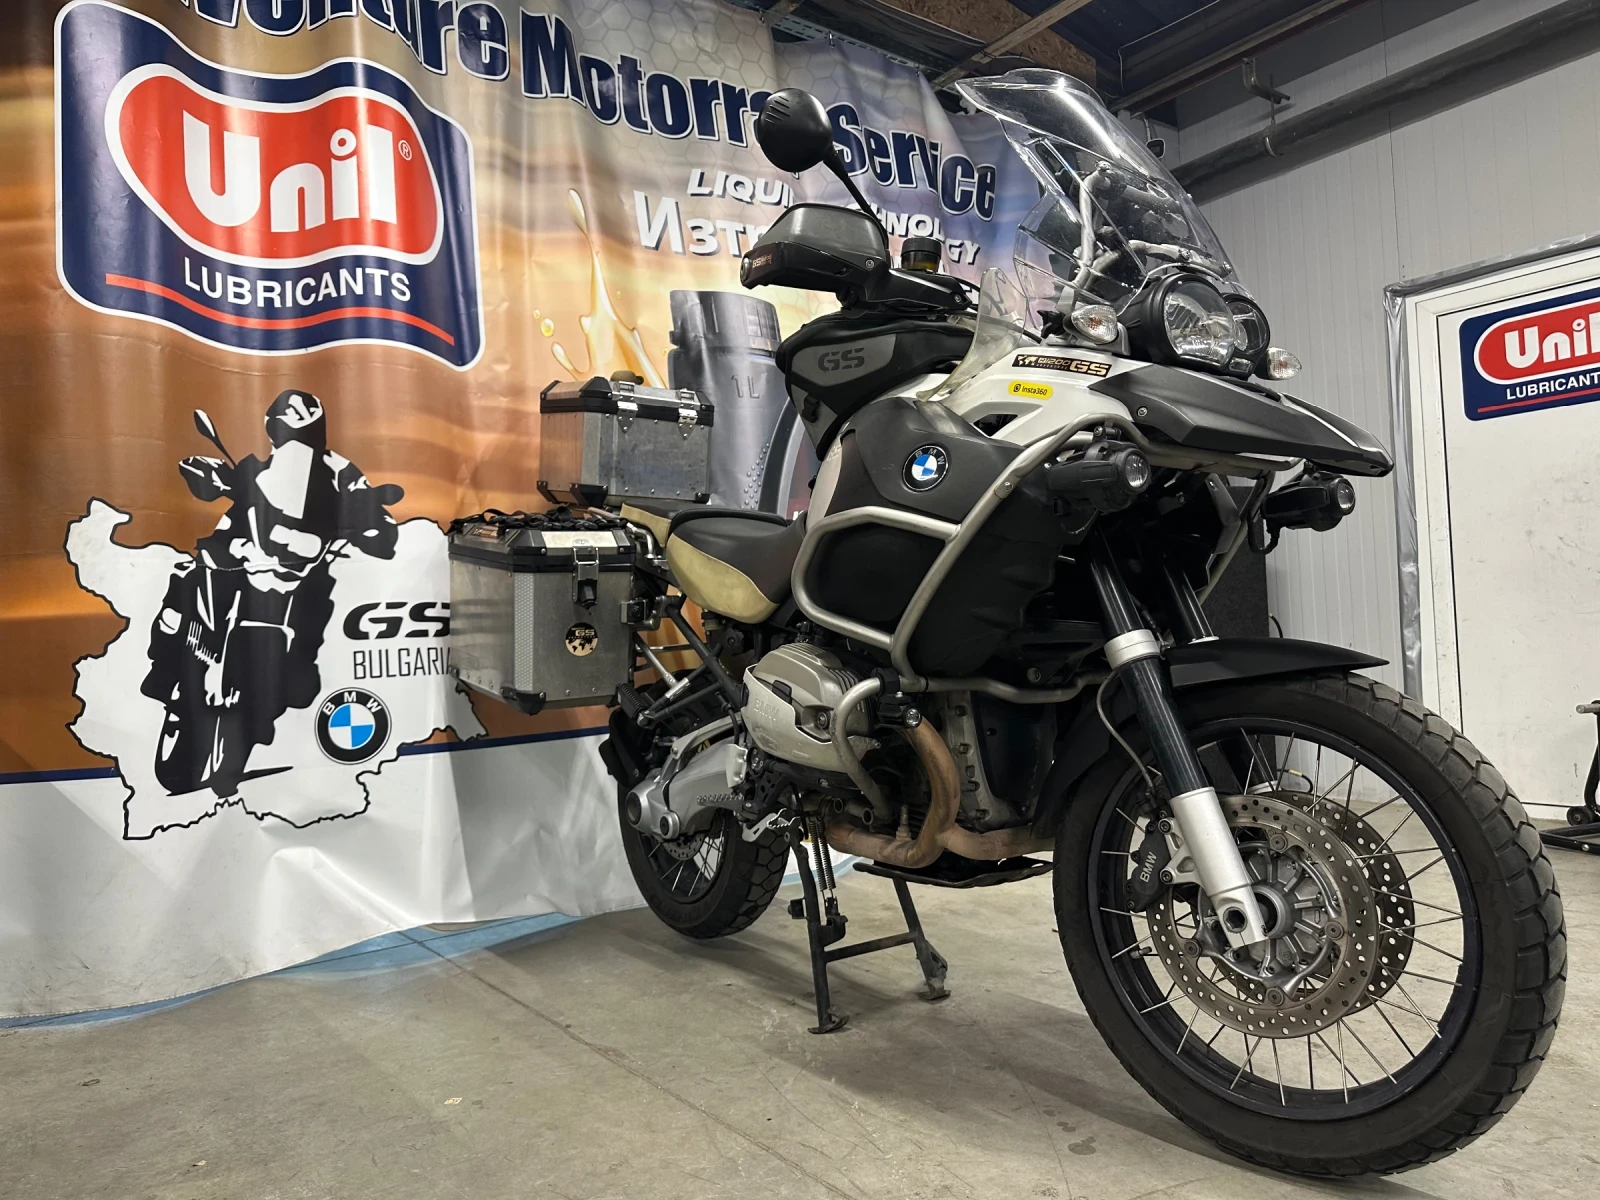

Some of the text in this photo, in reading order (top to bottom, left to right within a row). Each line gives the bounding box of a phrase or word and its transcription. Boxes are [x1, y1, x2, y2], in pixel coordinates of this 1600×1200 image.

[519, 13, 799, 179] Motorr
[825, 102, 997, 222] Service
[183, 109, 398, 233] Unil
[686, 168, 796, 208] LIQUI
[184, 256, 411, 308] LUBRICANTS
[1504, 311, 1600, 369] Unil
[817, 347, 865, 372] GS
[1069, 360, 1109, 375] GS
[730, 374, 760, 399] 1L
[1506, 372, 1600, 400] LUBRICANT
[914, 447, 945, 465] BMW
[343, 601, 450, 640] GS
[322, 691, 382, 716] BMW
[1139, 851, 1157, 883] BMW
